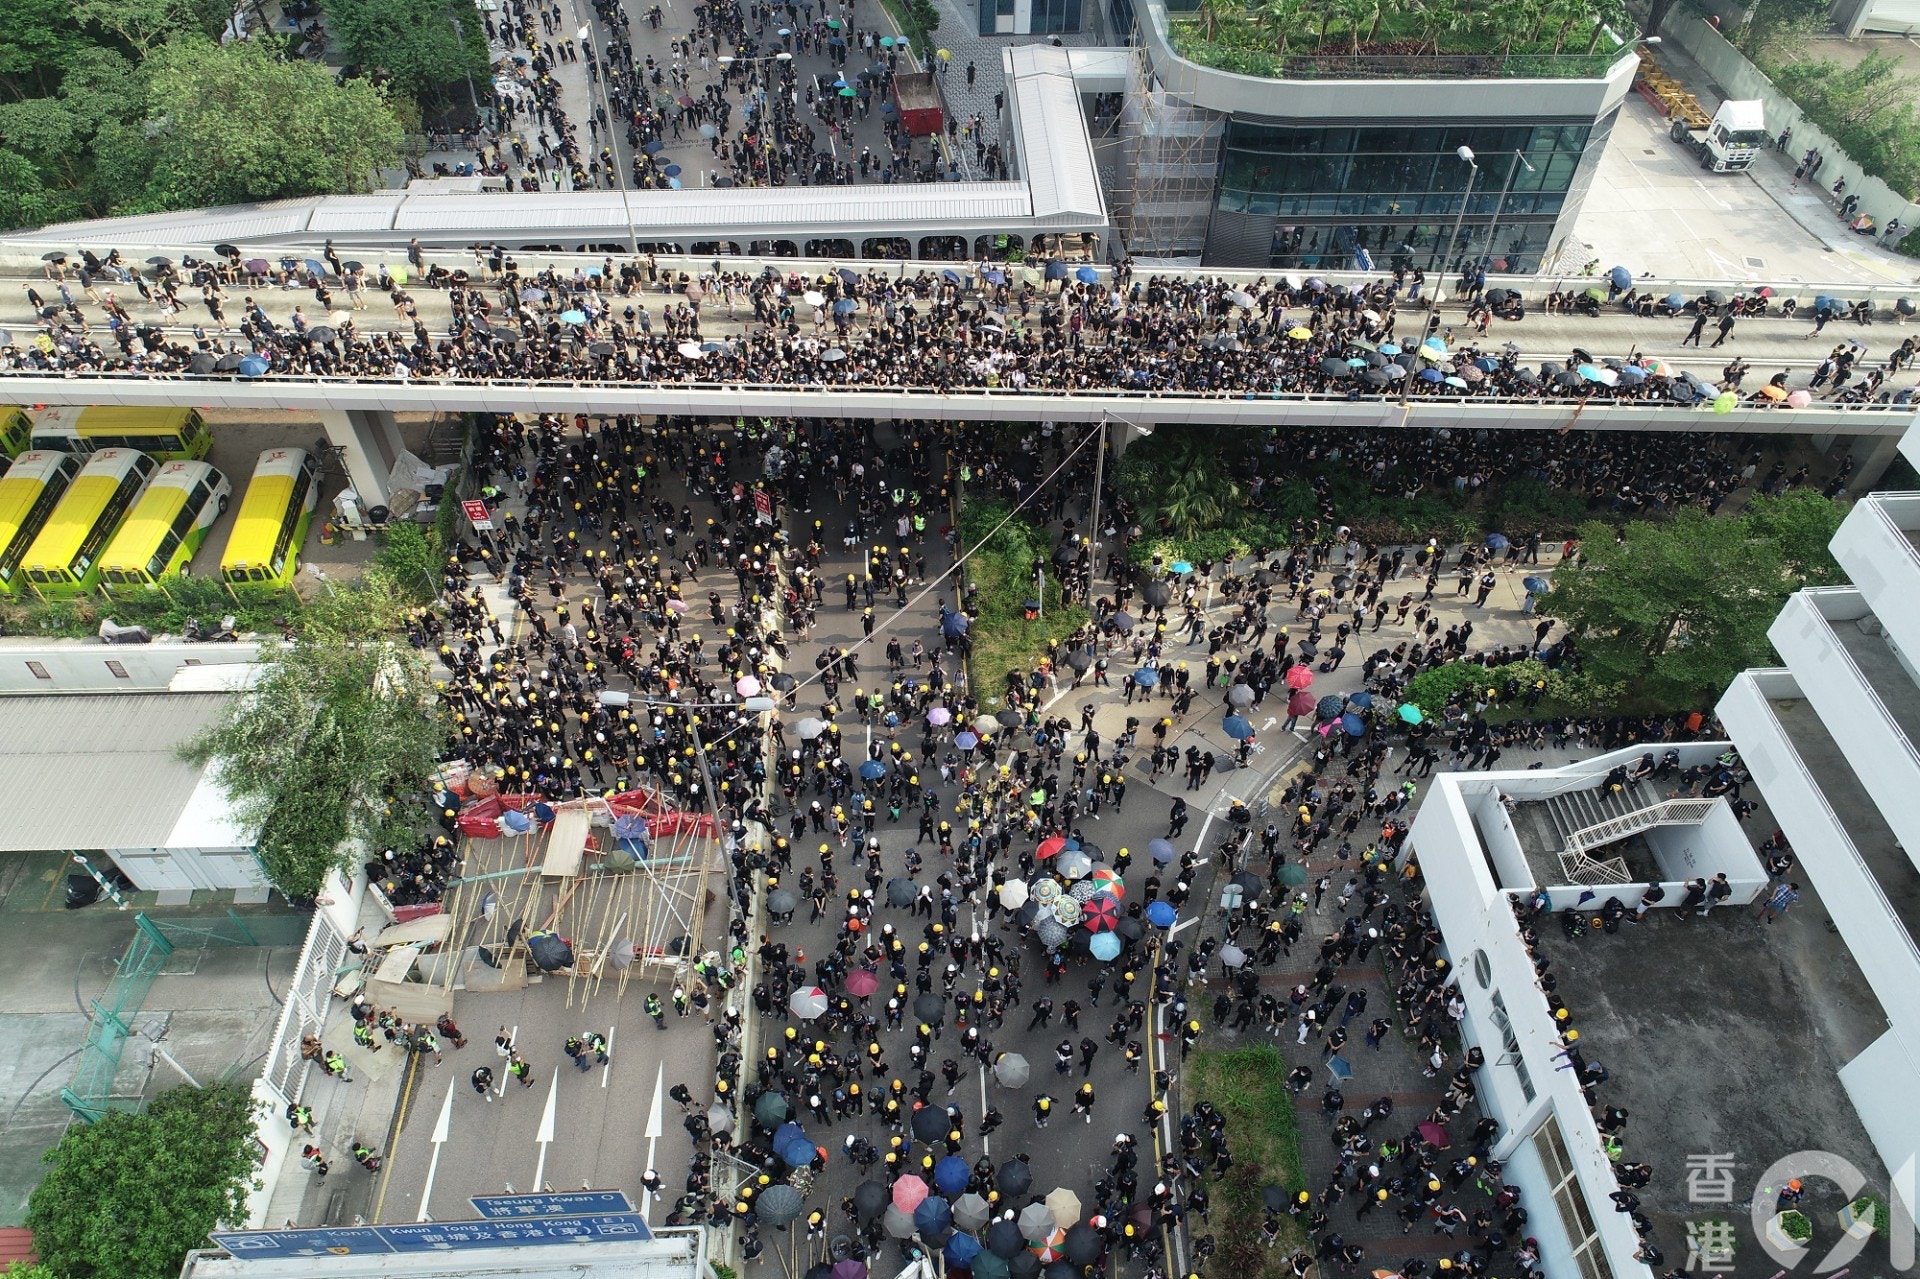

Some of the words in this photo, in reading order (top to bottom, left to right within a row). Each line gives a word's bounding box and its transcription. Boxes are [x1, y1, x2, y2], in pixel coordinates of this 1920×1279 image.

[483, 1196, 543, 1206] Tseung
[549, 1195, 593, 1204] Kwan
[488, 1204, 565, 1216] 將軍澳
[389, 1226, 431, 1235] Kwun
[494, 1222, 533, 1231] Hong
[542, 1219, 582, 1227] Kong
[327, 1230, 373, 1238] Kong
